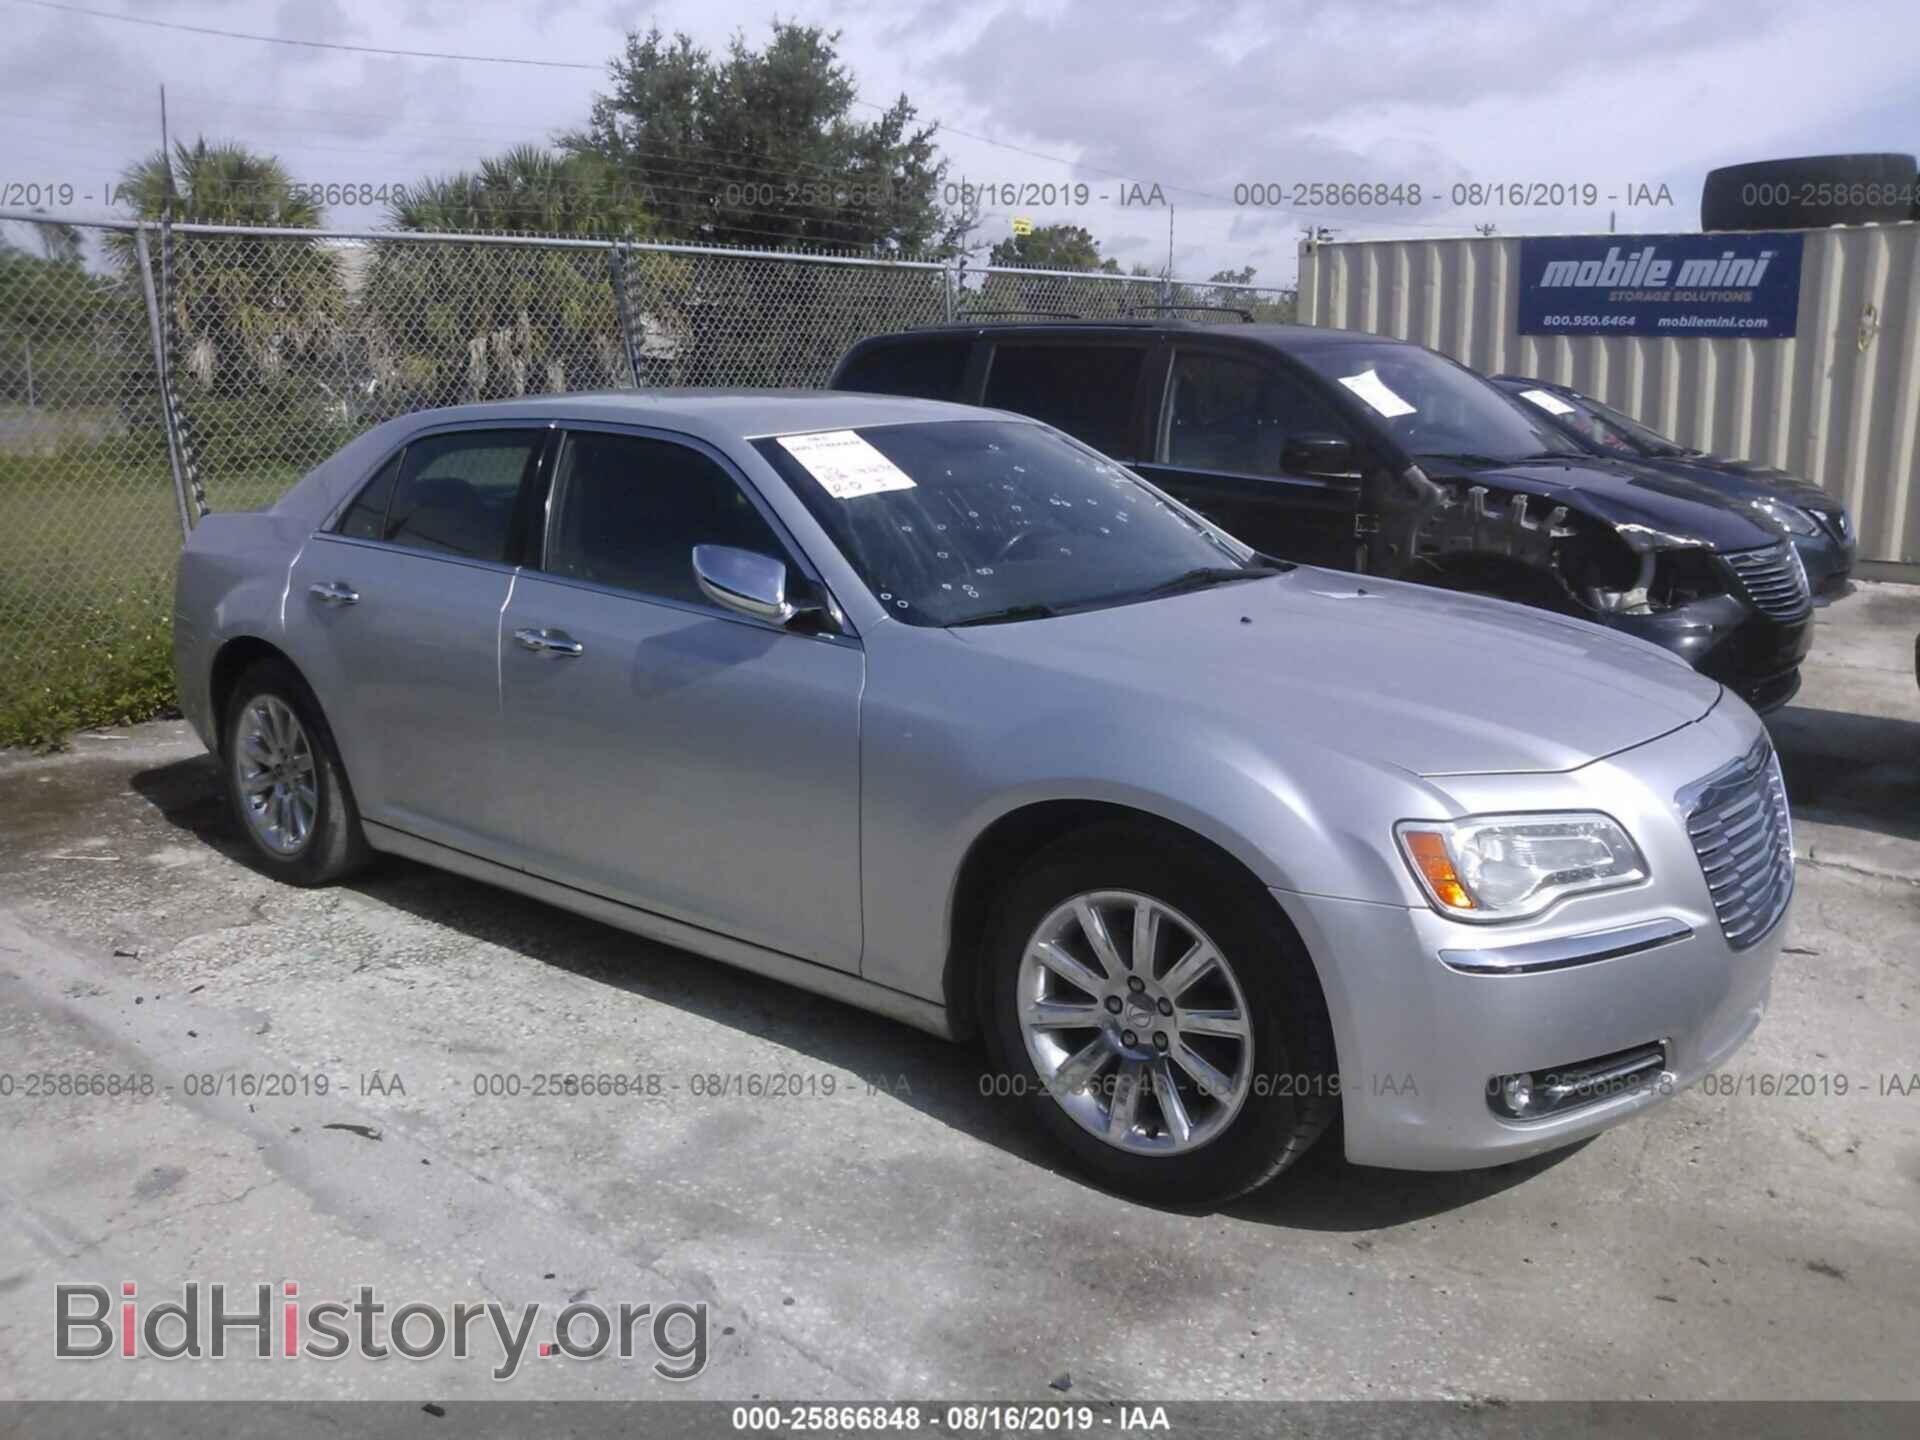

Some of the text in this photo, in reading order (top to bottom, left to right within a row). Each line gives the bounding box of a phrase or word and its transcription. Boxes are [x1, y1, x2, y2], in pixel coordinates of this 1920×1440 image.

[1540, 246, 1774, 288] mobile mini
[1608, 290, 1752, 302] STORAGE SOLUTIONS
[1543, 315, 1636, 327] 800.950.6464
[1657, 316, 1768, 328] mobilemini.com
